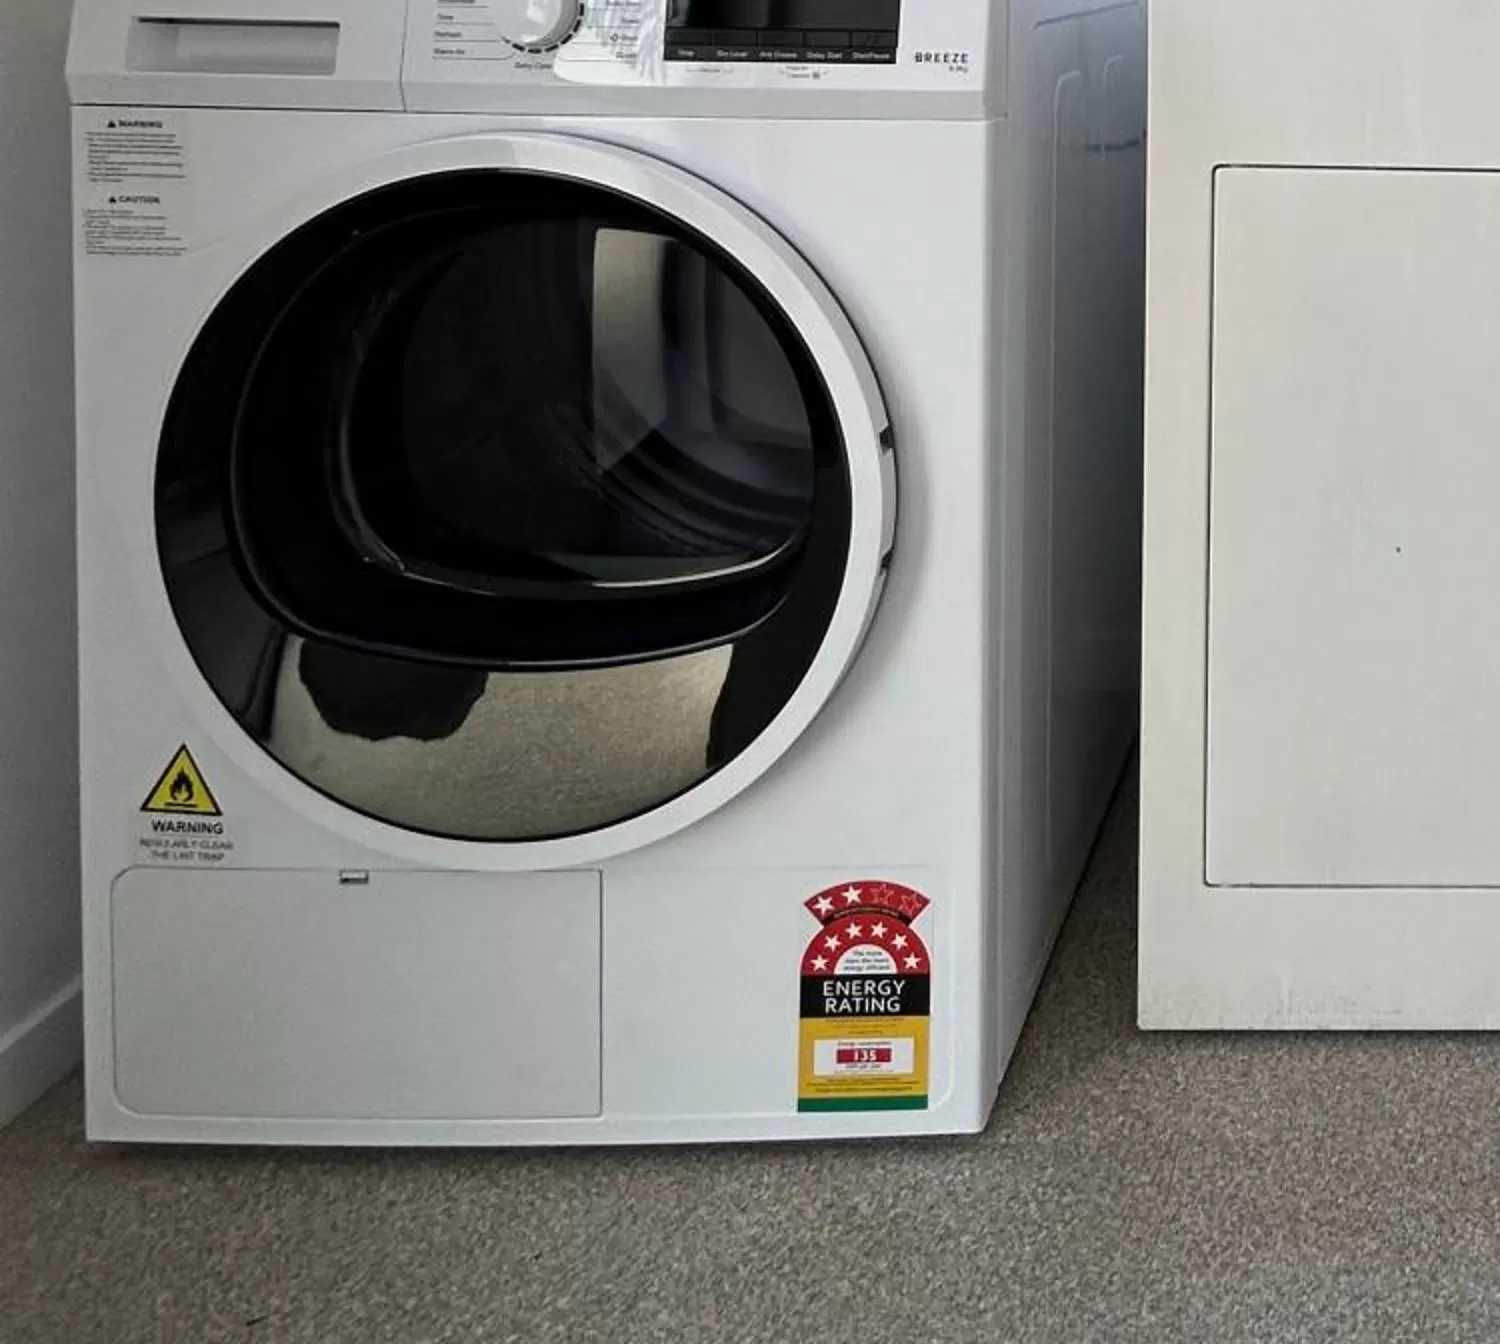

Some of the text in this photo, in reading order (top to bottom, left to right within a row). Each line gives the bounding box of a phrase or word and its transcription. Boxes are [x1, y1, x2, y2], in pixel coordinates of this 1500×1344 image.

[914, 51, 970, 64] BREEZE
[152, 819, 225, 835] WARNING
[823, 979, 906, 998] ENERGY
[824, 996, 901, 1015] RATING
[854, 1049, 877, 1062] 135
